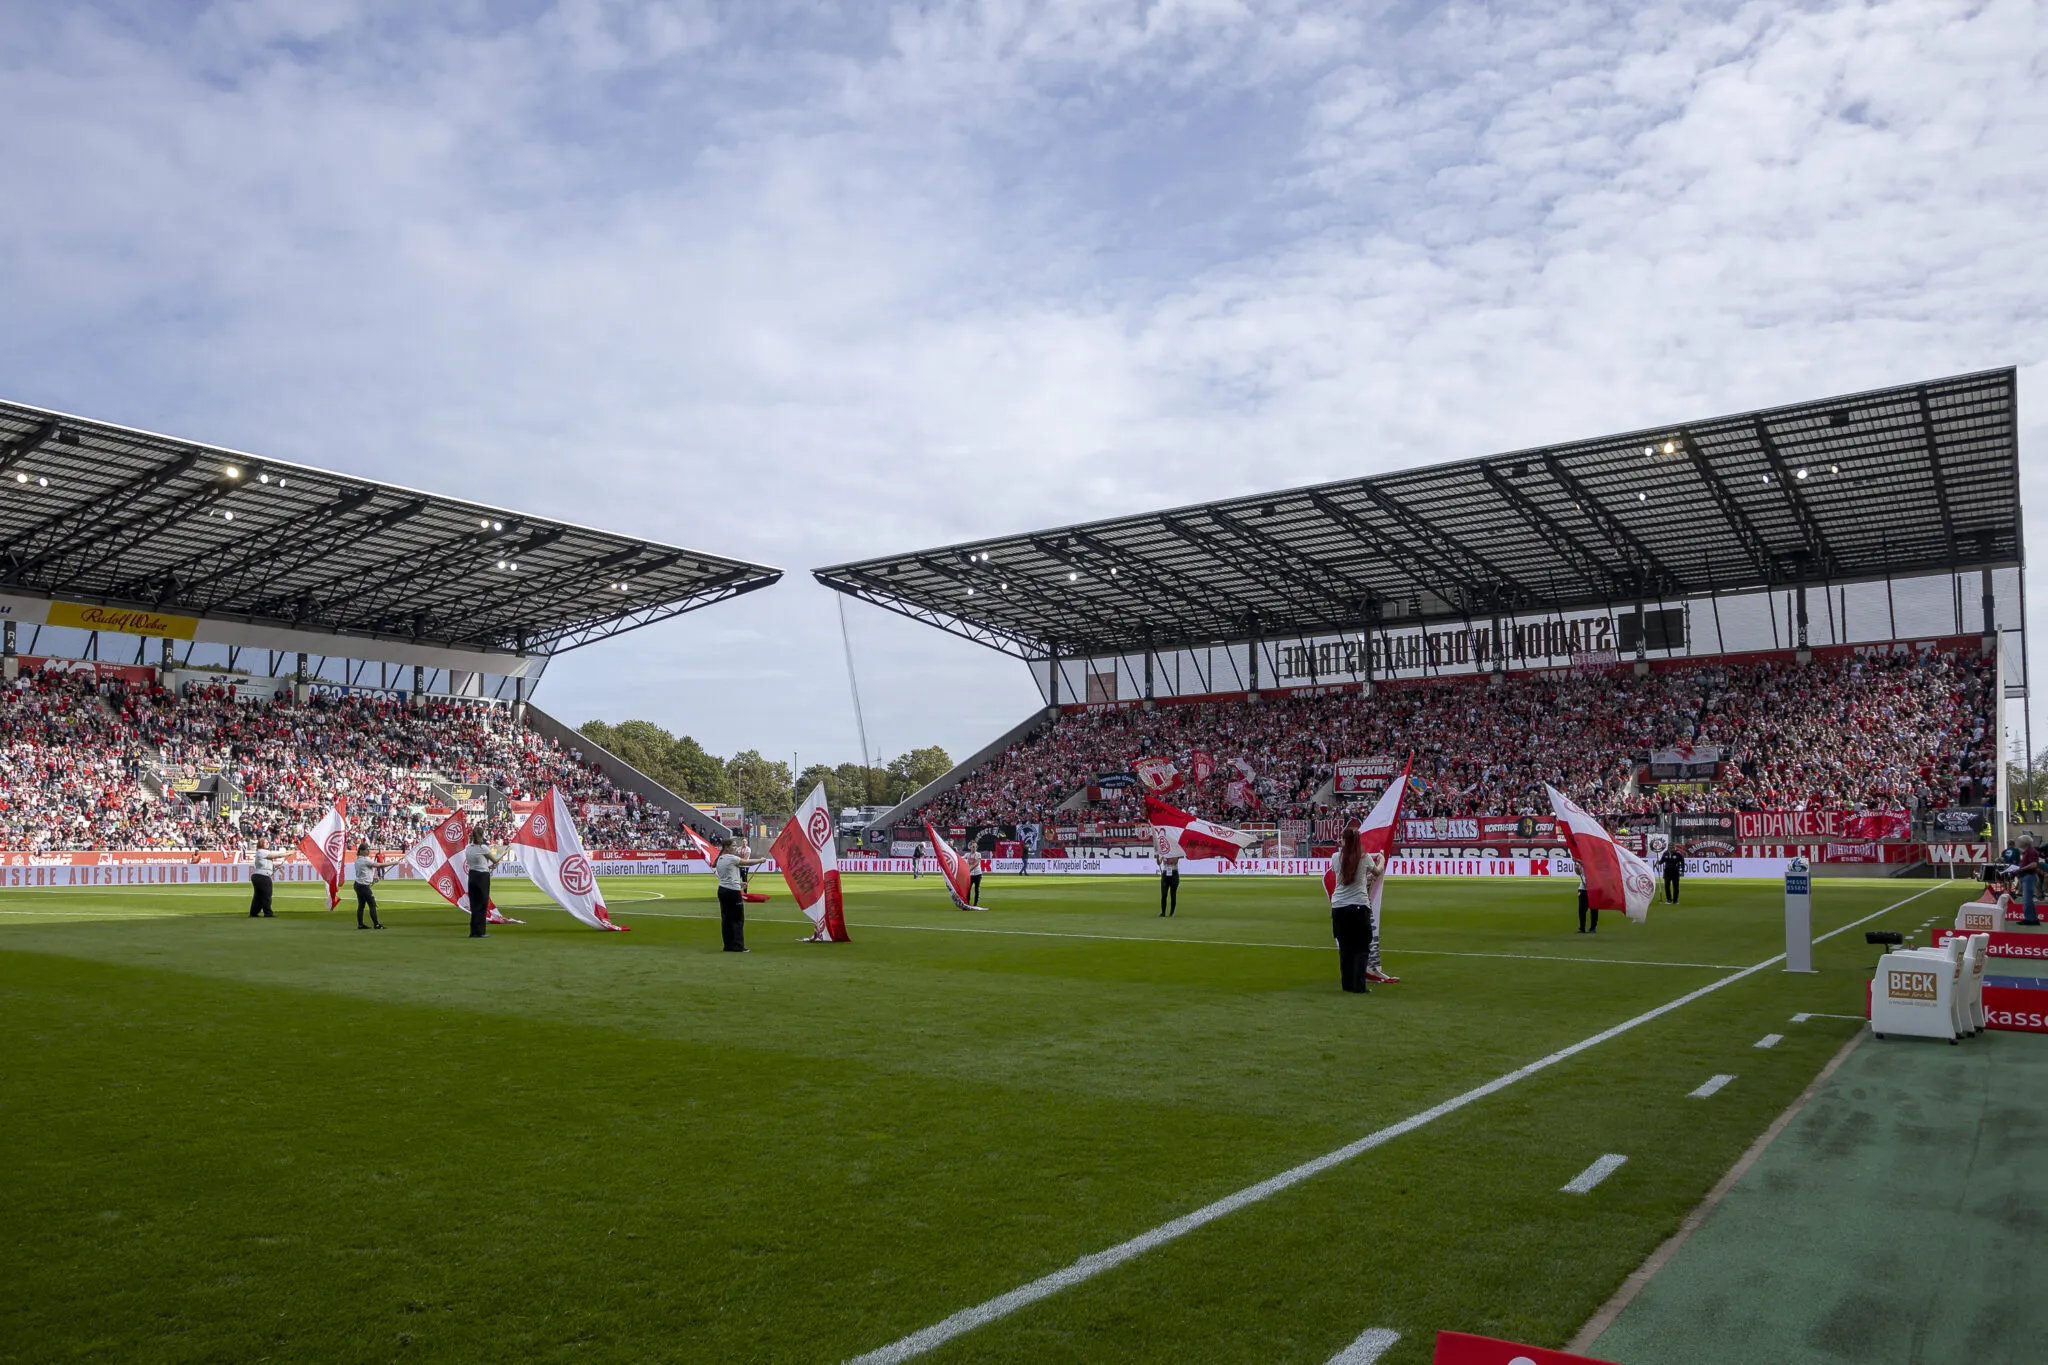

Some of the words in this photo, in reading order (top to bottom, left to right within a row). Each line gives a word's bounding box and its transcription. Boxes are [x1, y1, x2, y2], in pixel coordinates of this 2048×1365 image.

[81, 608, 129, 631] Rudolf
[130, 613, 168, 631] Weber
[1927, 844, 1988, 863] WAZ
[591, 861, 635, 875] ealisieren
[637, 861, 660, 875] Ihren
[662, 861, 690, 874] Traum
[872, 860, 892, 872] WIRD
[1083, 860, 1101, 871] GmbH
[1392, 859, 1482, 875] PRÄSENTIERT
[1489, 860, 1515, 875] VON
[1703, 860, 1733, 873] GmbH
[0, 867, 57, 886] NSERE
[68, 866, 189, 885] AUFSTELLUNG
[199, 866, 239, 883] WIRD
[1966, 915, 1992, 926] BECK
[1986, 943, 2048, 957] arkasse
[1890, 972, 1935, 992] BECK
